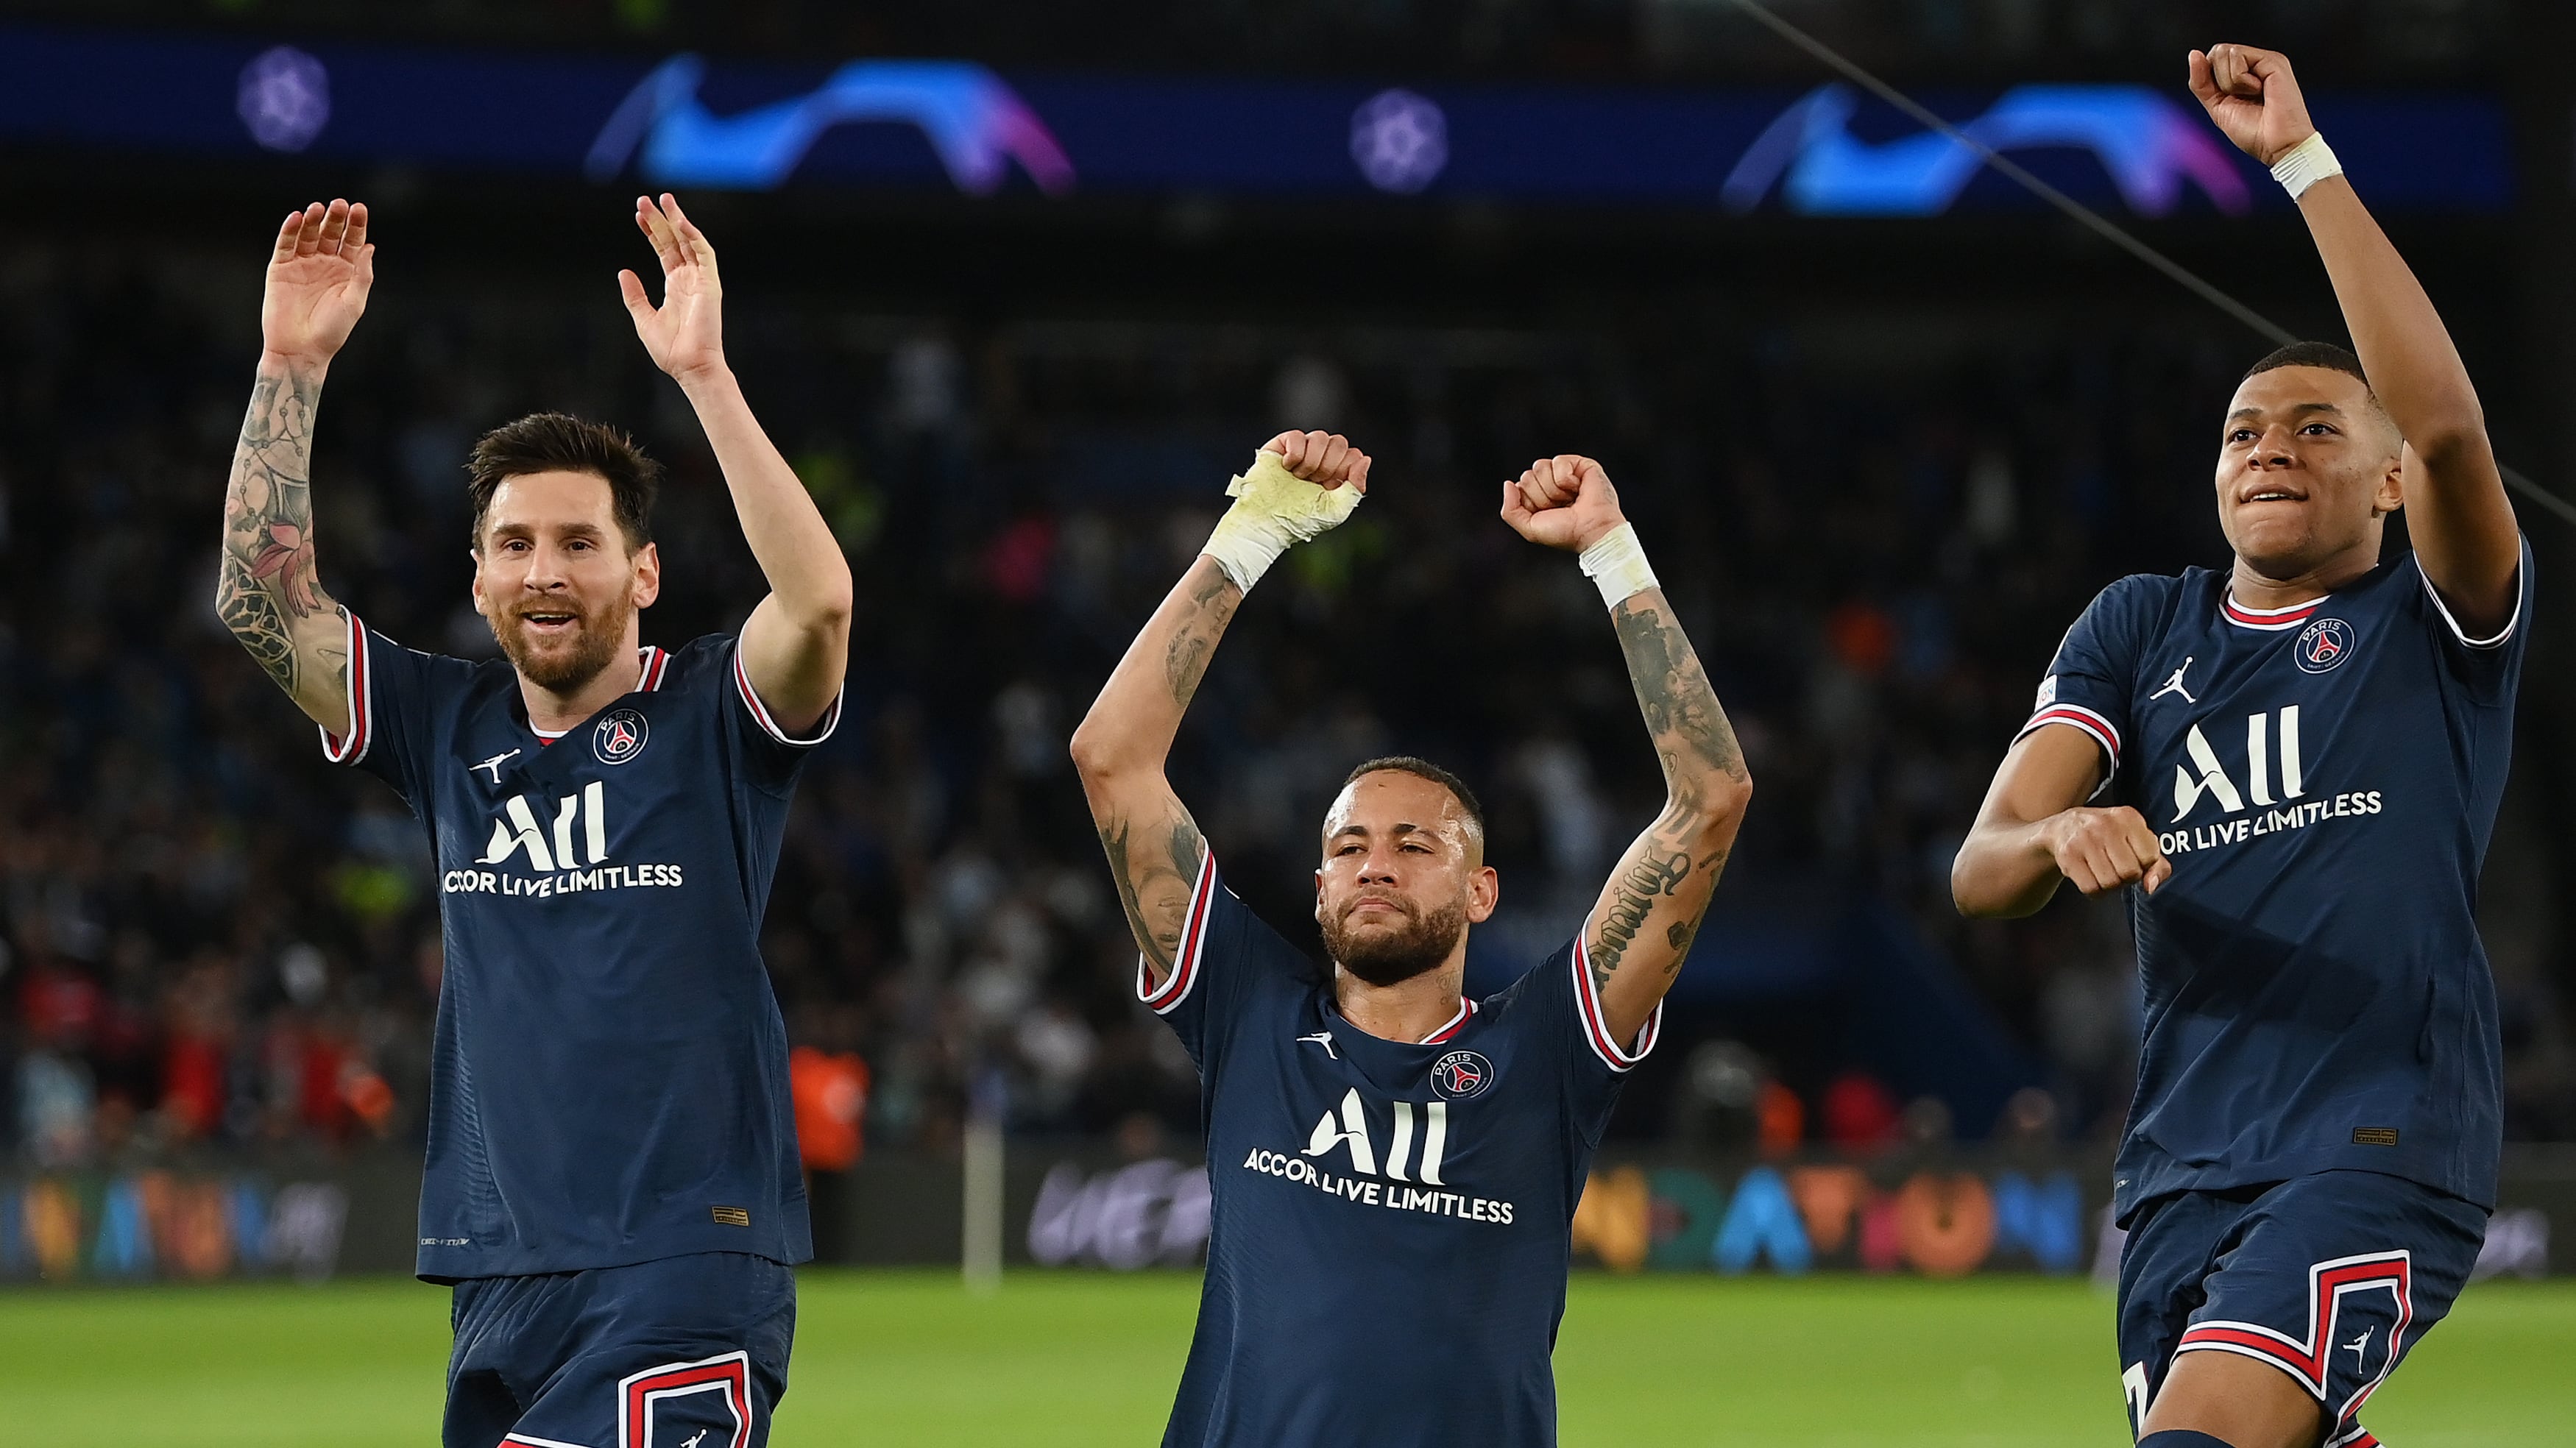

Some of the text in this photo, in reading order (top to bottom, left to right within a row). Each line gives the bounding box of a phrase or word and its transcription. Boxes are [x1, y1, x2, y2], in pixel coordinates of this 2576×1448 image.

[2302, 621, 2341, 641] PARIS
[600, 711, 637, 731] PARIS
[2195, 819, 2251, 850] LIVE
[2253, 791, 2382, 836] LIMITLESS
[502, 873, 553, 898] LIVE
[556, 864, 682, 894] LIMITLESS
[1434, 1054, 1471, 1076] PARIS
[1243, 1147, 1513, 1224] ACCOR LIVE LIMITLESS
